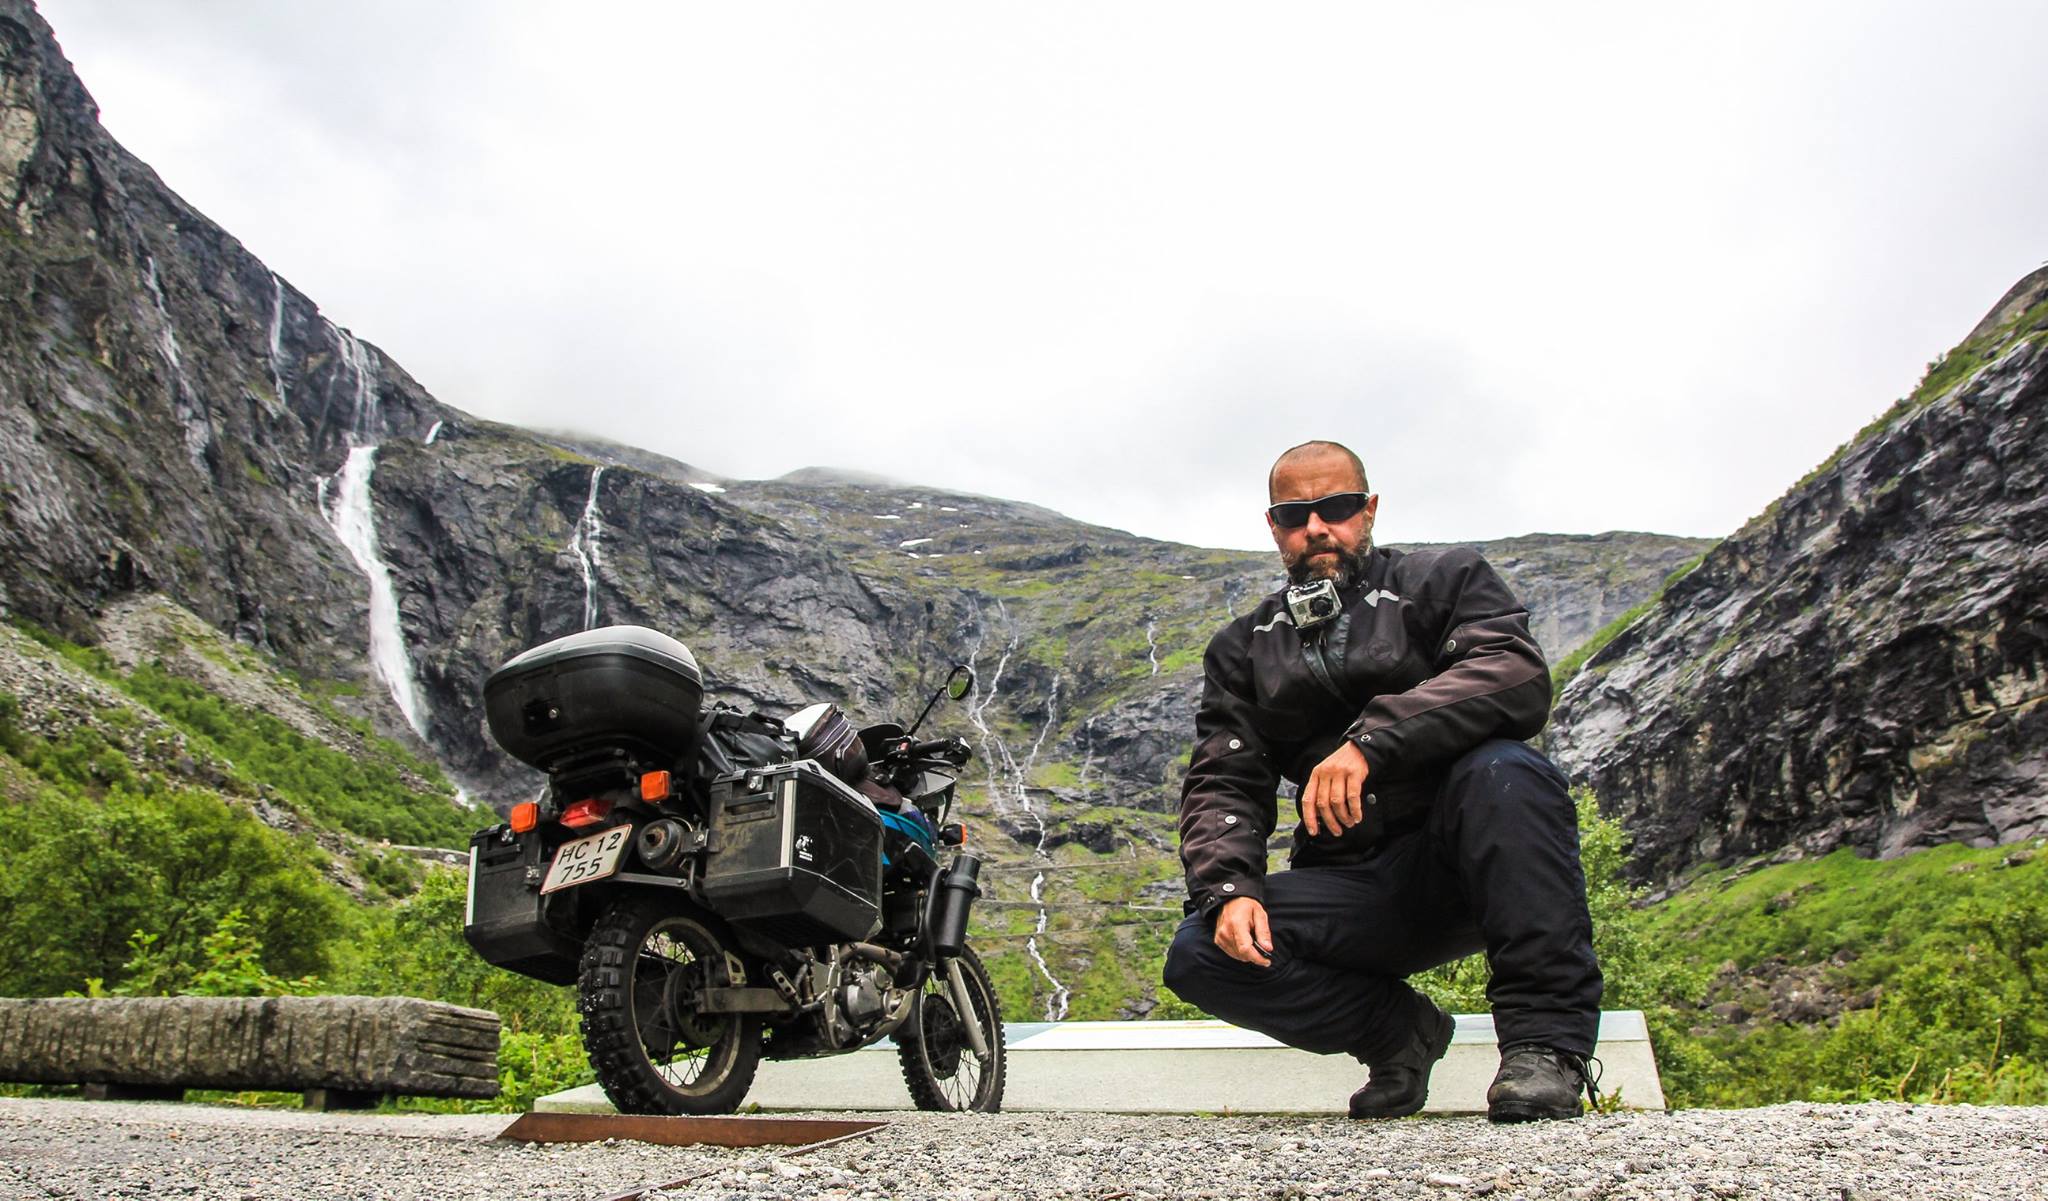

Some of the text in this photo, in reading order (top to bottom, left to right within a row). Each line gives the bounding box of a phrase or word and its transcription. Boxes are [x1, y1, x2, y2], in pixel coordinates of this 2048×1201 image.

[558, 832, 622, 865] HC 12
[560, 857, 603, 884] 755
